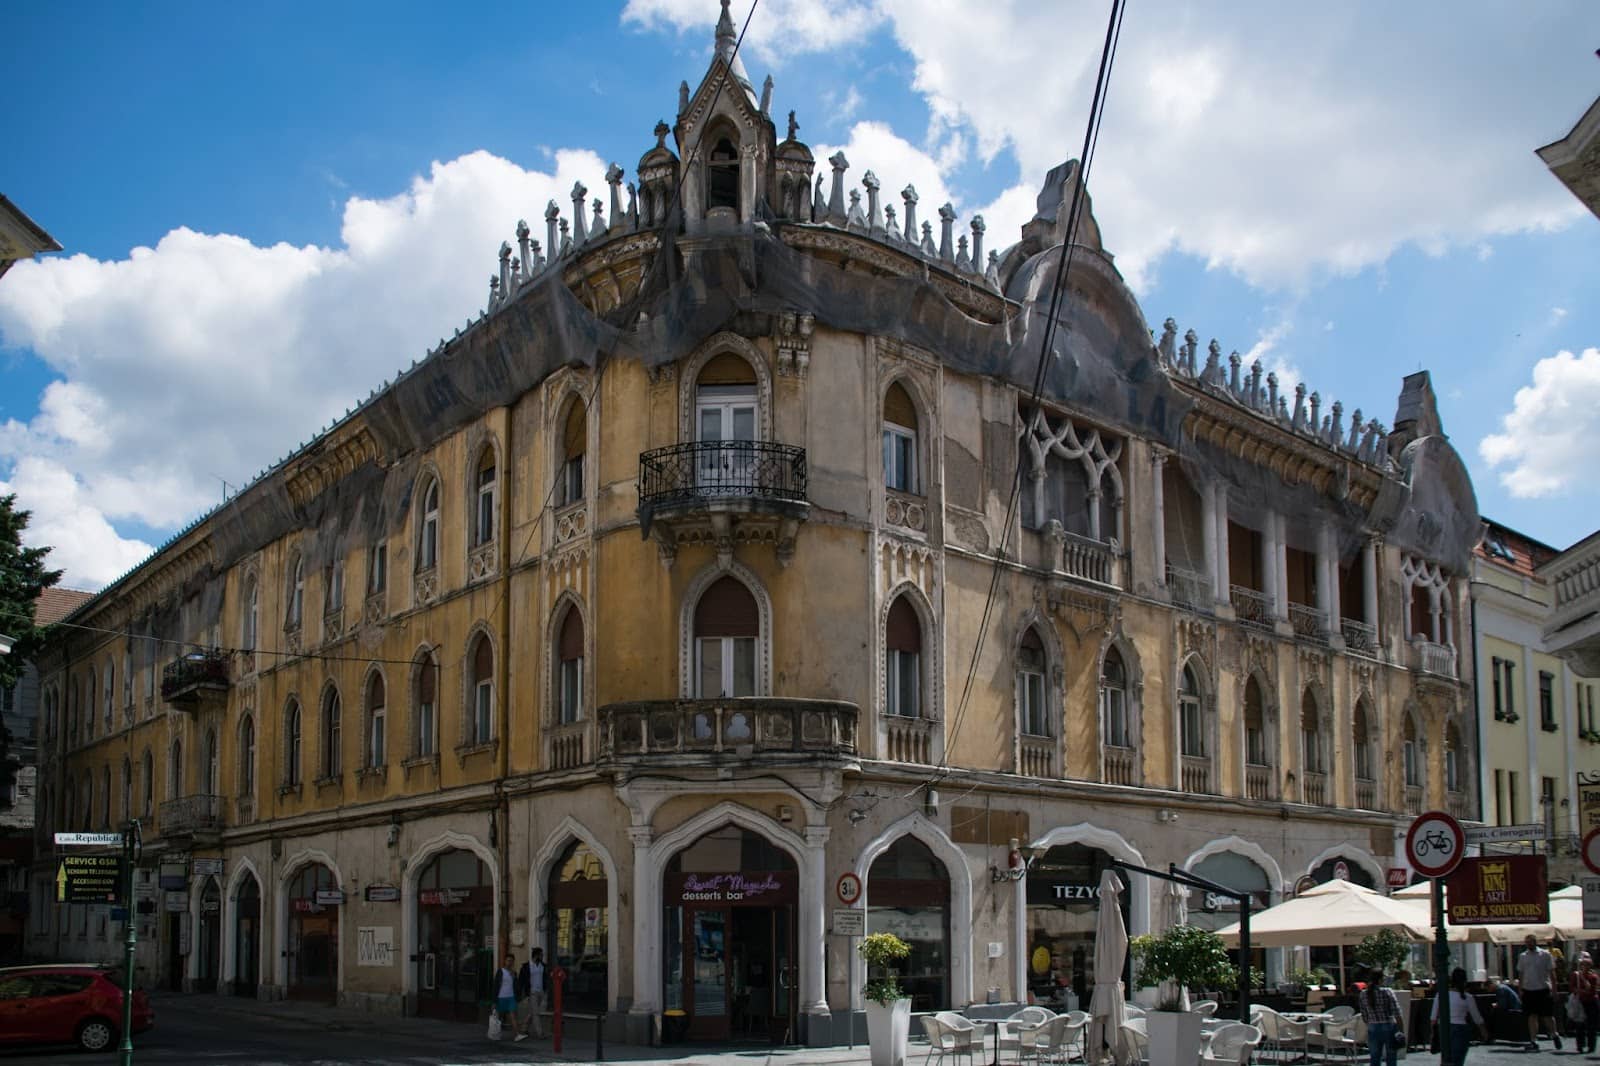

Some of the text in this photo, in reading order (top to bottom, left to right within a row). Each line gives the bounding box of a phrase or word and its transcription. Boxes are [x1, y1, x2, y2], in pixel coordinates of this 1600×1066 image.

[65, 857, 118, 866] SERVICE GSM
[1390, 871, 1405, 883] illy
[1483, 874, 1506, 892] KING
[682, 891, 744, 901] desserts bar
[1485, 891, 1506, 903] ART
[1452, 905, 1478, 917] GIFTS
[1489, 903, 1542, 916] SOUVENIRS
